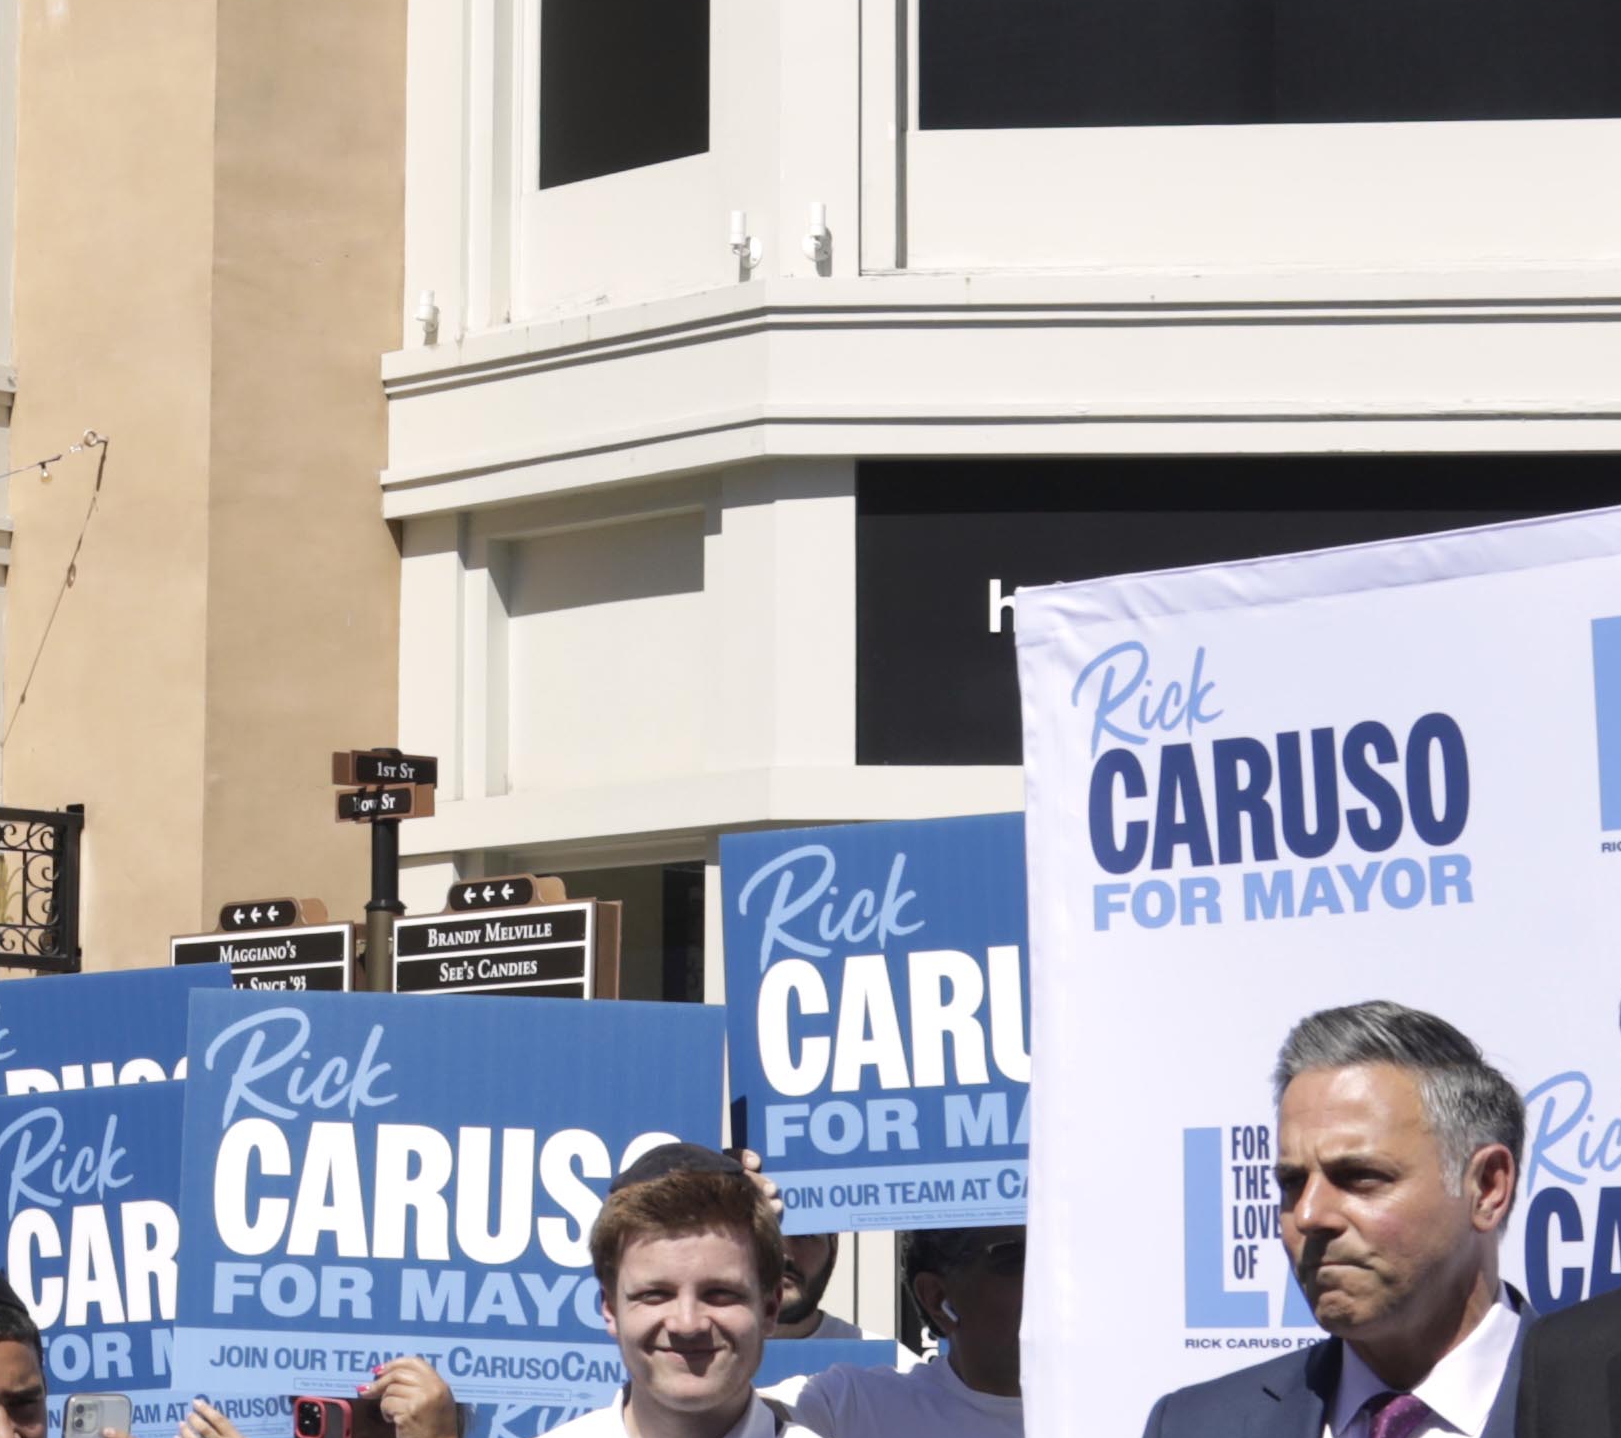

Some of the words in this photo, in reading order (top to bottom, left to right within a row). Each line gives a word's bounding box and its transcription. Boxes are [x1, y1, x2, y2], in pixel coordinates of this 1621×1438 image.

[1072, 640, 1224, 756] Rick
[1087, 710, 1471, 876] CARUSO
[1093, 870, 1220, 932] FOR
[1242, 852, 1474, 925] MAYOR
